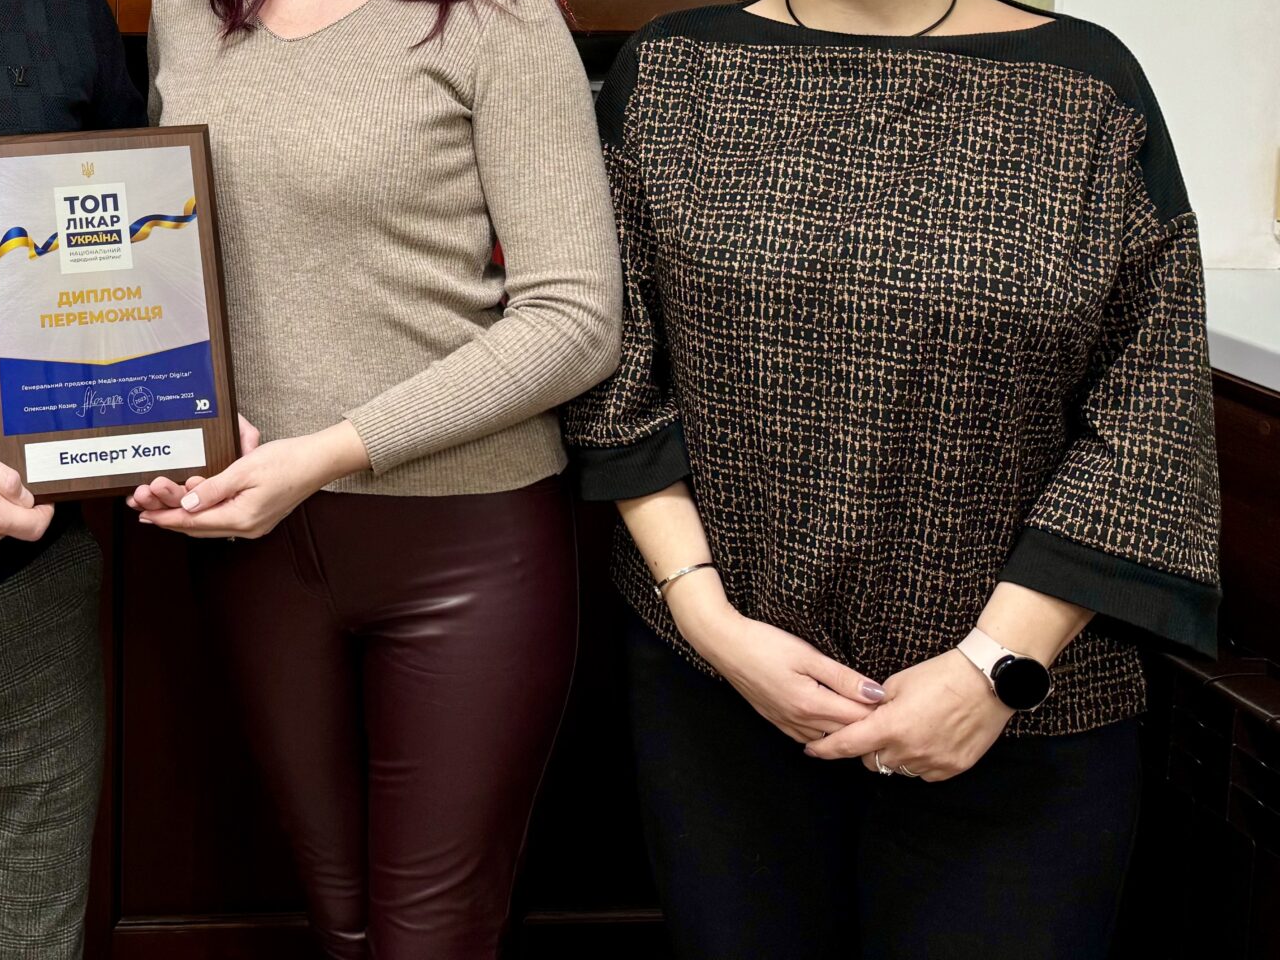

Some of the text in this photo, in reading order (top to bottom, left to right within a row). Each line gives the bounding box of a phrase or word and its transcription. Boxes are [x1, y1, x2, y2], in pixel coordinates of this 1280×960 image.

[63, 193, 119, 215] ТОП
[65, 214, 121, 230] ЛІКАР
[69, 232, 119, 245] УКРАЇНА
[57, 285, 142, 308] ДИПЛОМ
[39, 305, 163, 328] ПЕРЕМОЖЦЯ
[21, 382, 63, 391] Генеральний
[64, 379, 97, 388] продюсер
[156, 393, 180, 402] Грудень
[23, 402, 77, 412] Олександр Козир
[59, 444, 171, 466] Експерт Хелс
